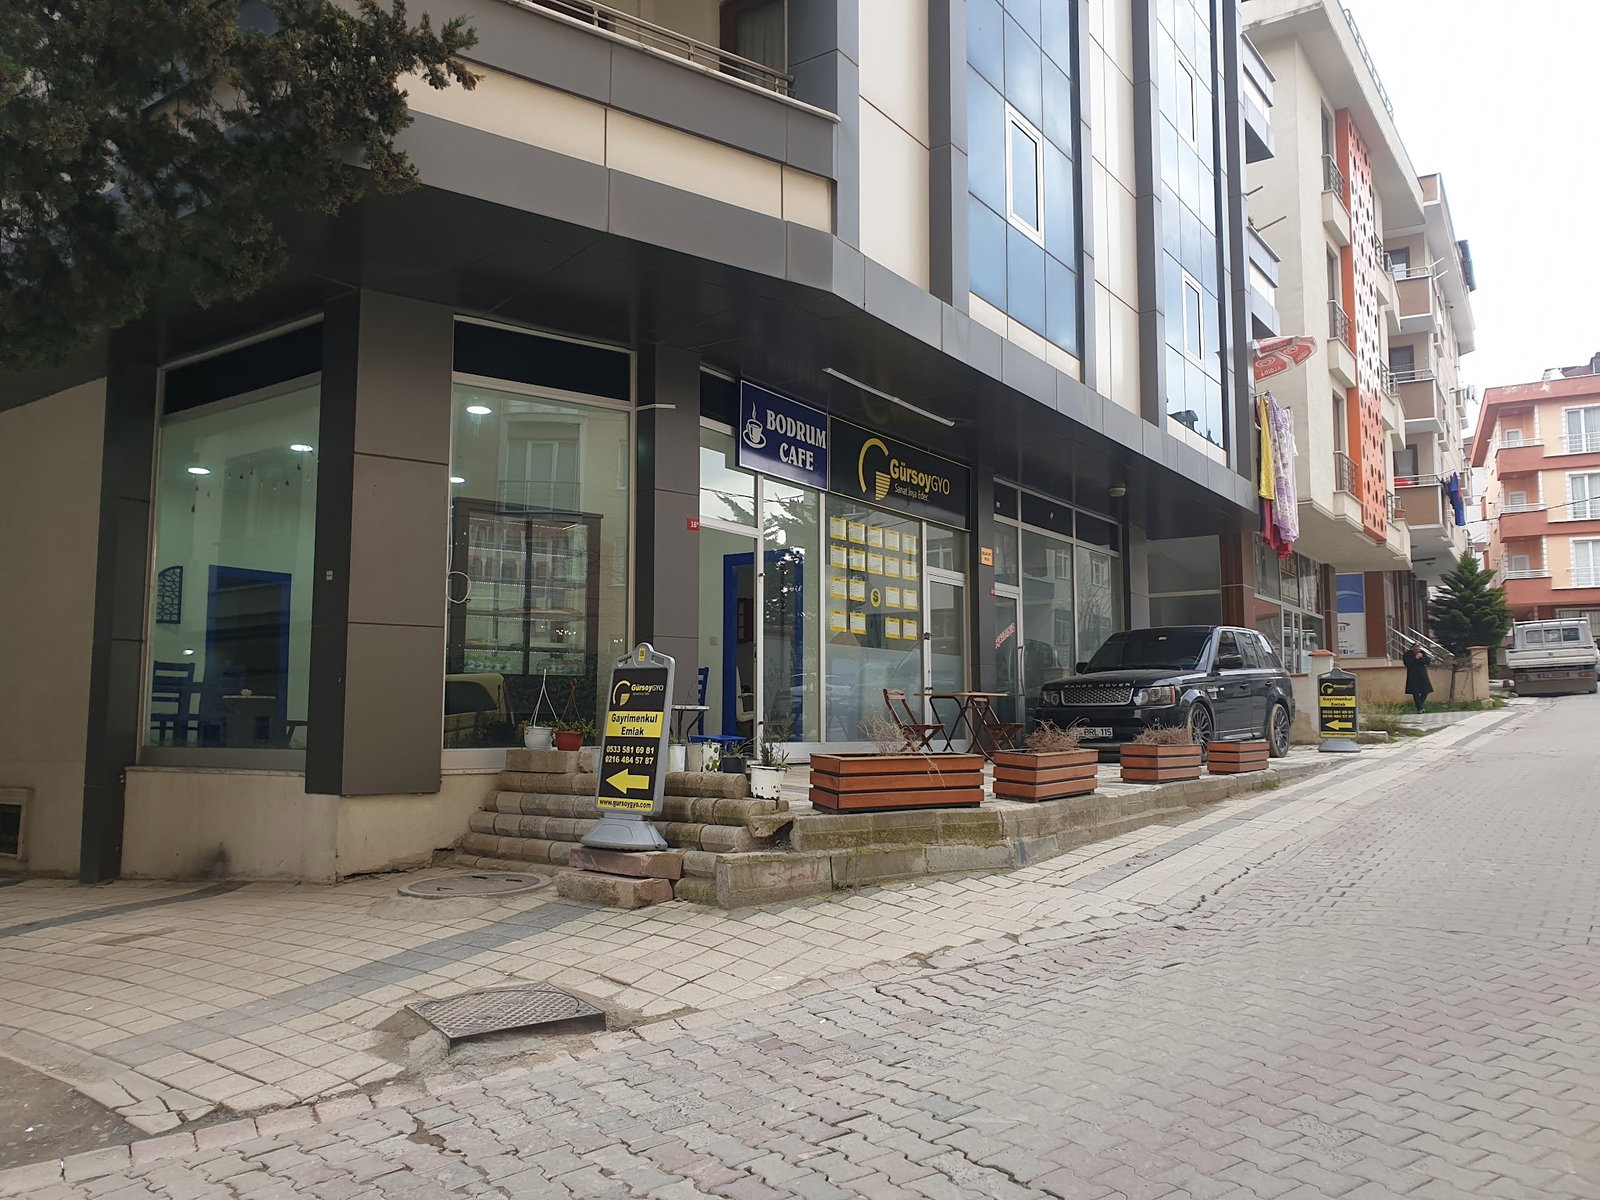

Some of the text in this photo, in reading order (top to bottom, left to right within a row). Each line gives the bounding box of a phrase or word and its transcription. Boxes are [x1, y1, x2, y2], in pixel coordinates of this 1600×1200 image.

[766, 409, 826, 449] BODRUM
[779, 442, 813, 471] CAFE
[889, 458, 950, 495] GürsoyGYO
[611, 713, 658, 724] Gayrimenkul
[621, 726, 645, 736] Emlak
[1100, 728, 1112, 736] 115
[606, 745, 621, 753] 0533
[635, 746, 645, 754] 69
[605, 755, 655, 765] 0216 484 57 87
